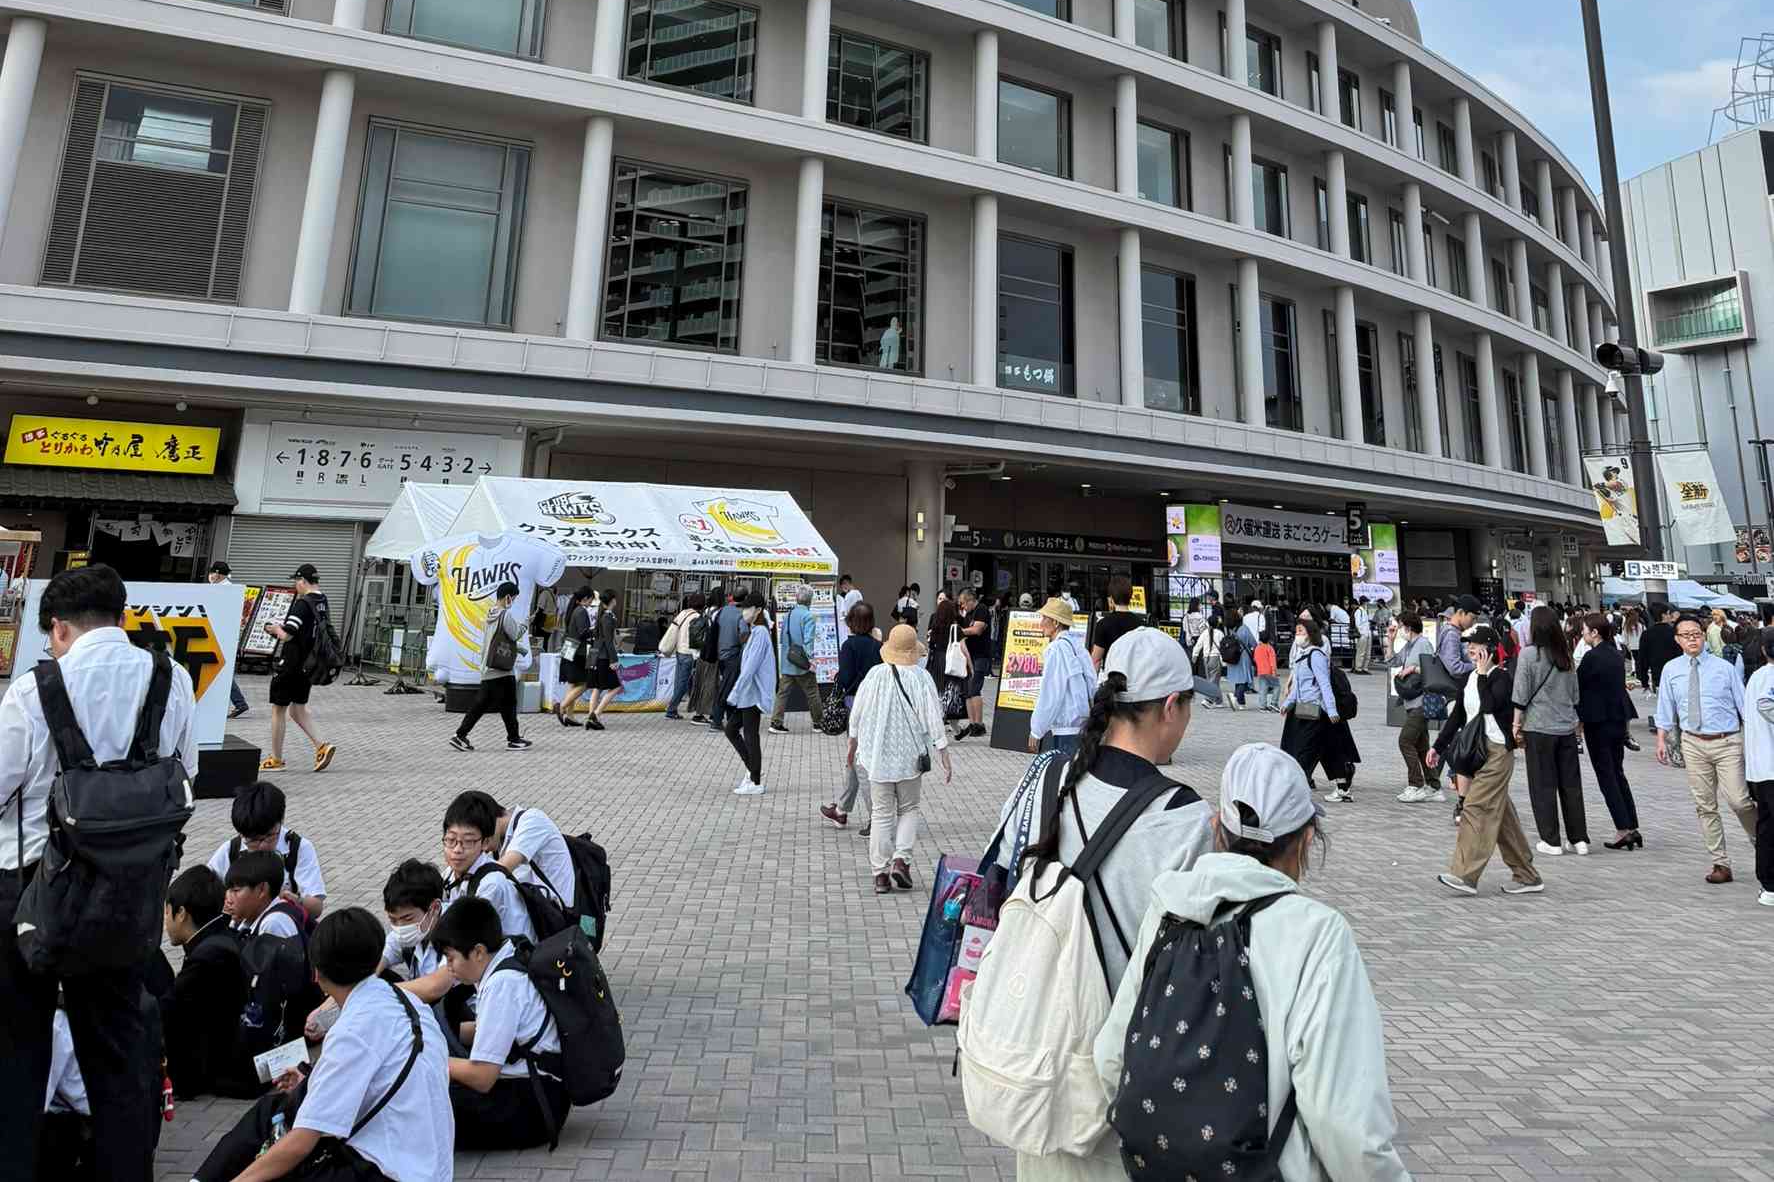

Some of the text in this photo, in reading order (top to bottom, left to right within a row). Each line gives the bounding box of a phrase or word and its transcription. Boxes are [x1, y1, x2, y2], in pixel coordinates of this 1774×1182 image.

[39, 441, 95, 458] とりかわ
[1620, 457, 1629, 469] 9
[317, 471, 326, 482] R
[360, 473, 367, 484] L
[541, 501, 605, 516] HAWKS
[1349, 509, 1361, 530] 5
[518, 522, 661, 538] クラブホークス
[972, 531, 981, 546] 5
[451, 561, 522, 595] HAWKS
